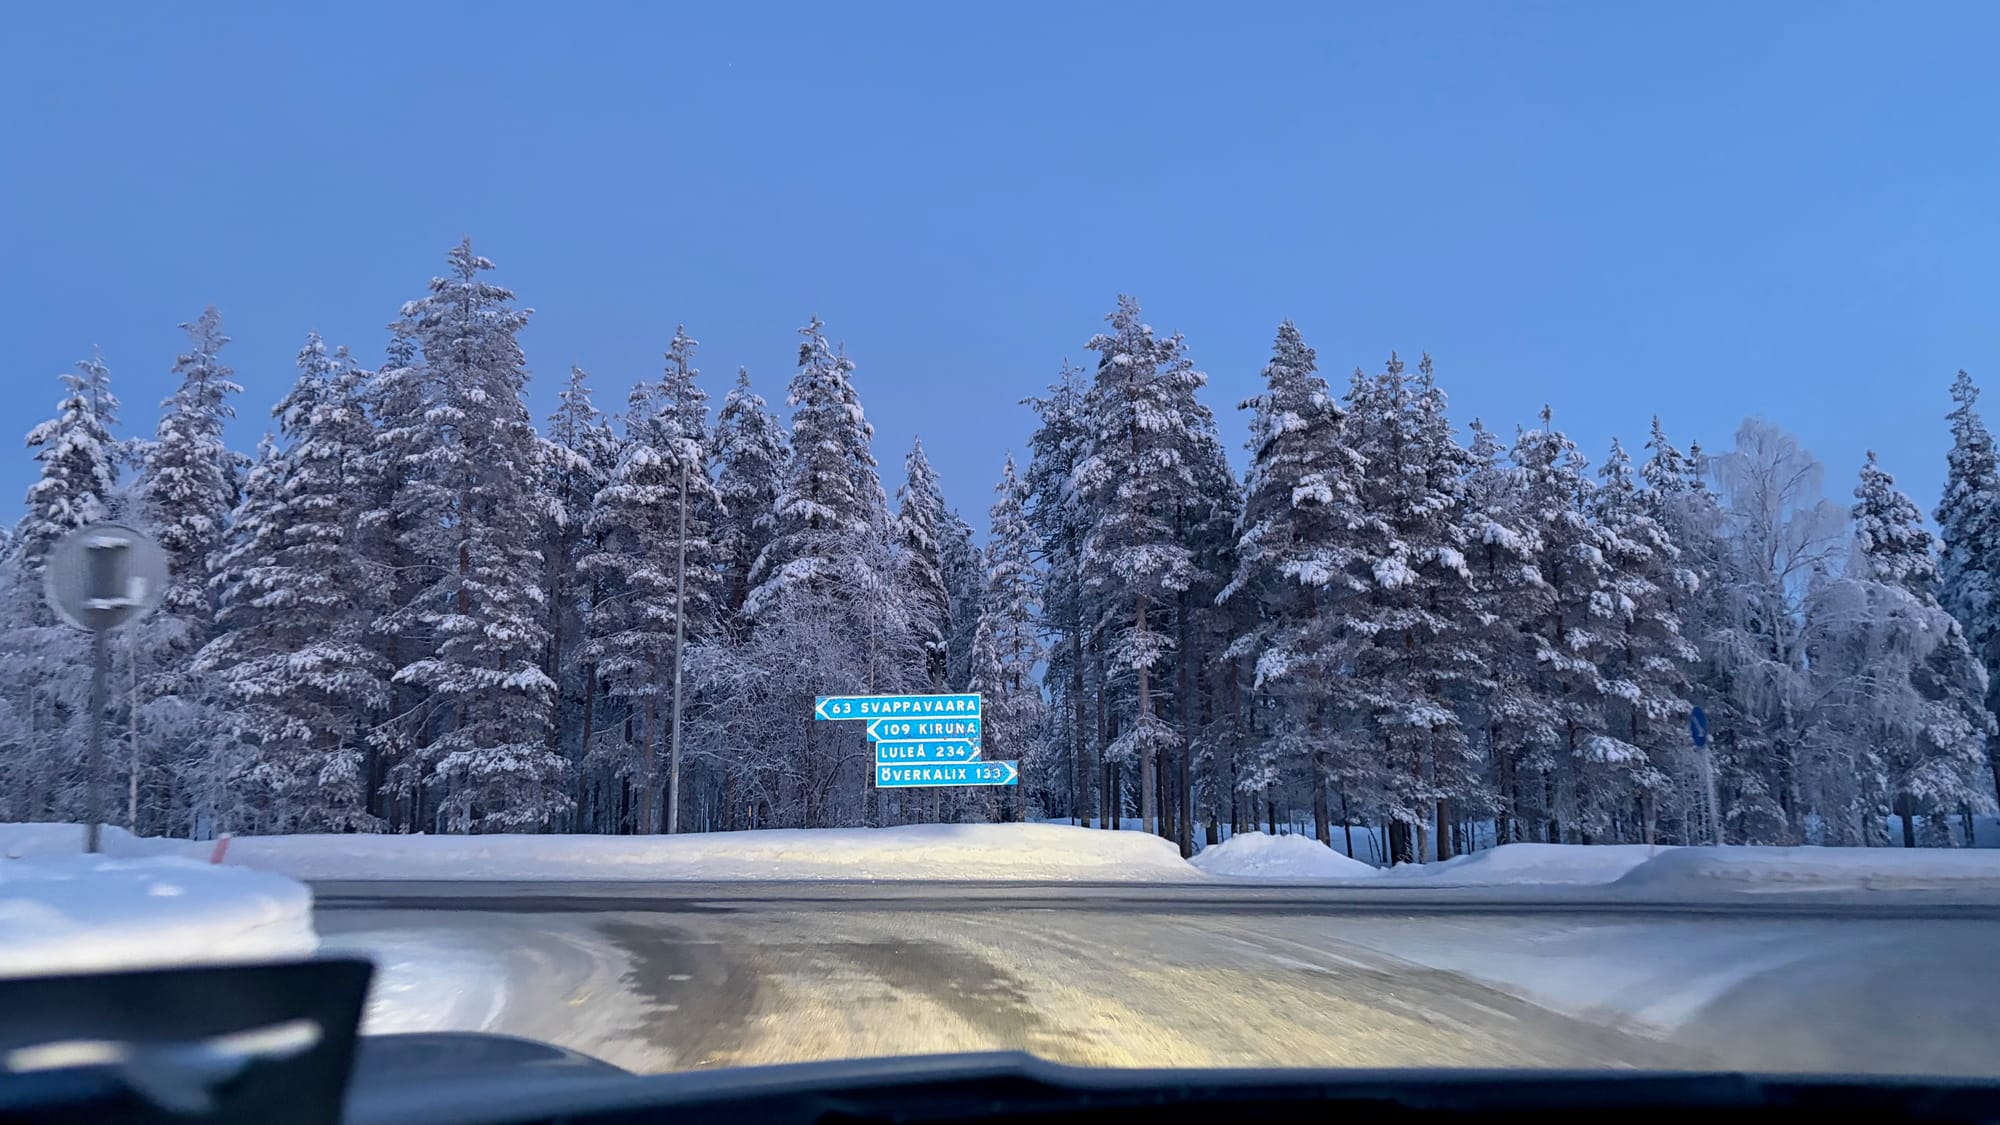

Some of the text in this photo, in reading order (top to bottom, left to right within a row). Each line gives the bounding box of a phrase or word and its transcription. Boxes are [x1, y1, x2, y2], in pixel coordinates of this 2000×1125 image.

[832, 700, 976, 714] 63 SVAPPAVAARA
[883, 723, 976, 736] 109 KIRUNA
[881, 744, 966, 758] LULEÅ 234
[881, 768, 1001, 781] ÖVERKALIX 133
